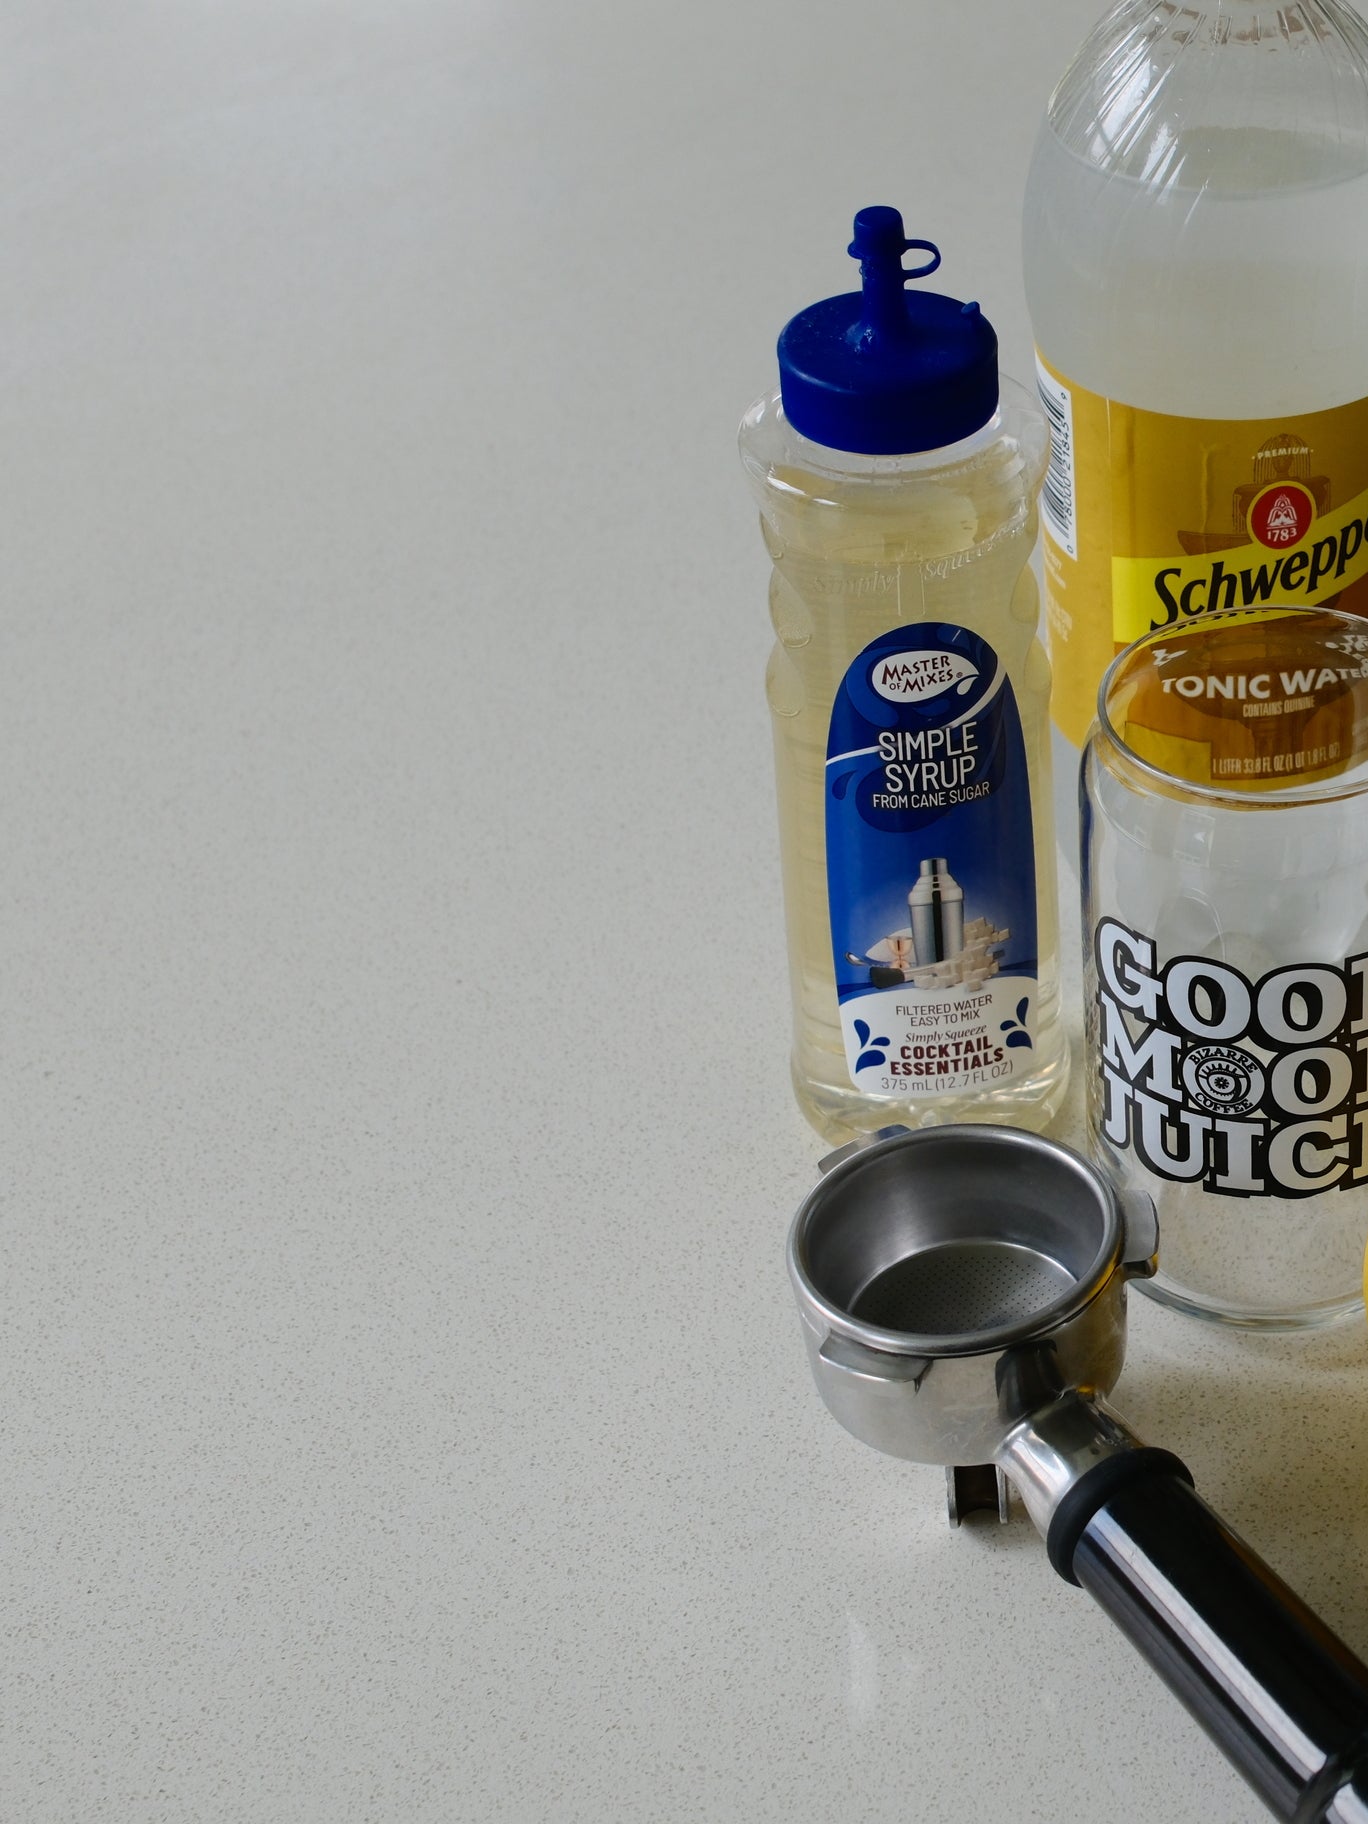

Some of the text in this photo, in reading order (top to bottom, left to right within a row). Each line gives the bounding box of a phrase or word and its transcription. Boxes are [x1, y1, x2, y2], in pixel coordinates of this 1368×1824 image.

[1257, 446, 1309, 460] PREMIUM
[1267, 526, 1298, 542] 1783
[881, 655, 951, 685] MASTER
[889, 682, 902, 691] OF
[1162, 674, 1271, 700] TONIC
[1242, 701, 1283, 718] CONTAINS
[878, 721, 979, 762] SIMPLE
[885, 754, 976, 793] SYRUP
[872, 781, 990, 809] FROM CANE SUGAR
[896, 993, 993, 1016] FILTERED WATER
[910, 1008, 980, 1027] EASY TO MIX
[905, 1024, 987, 1044] Simply Squeeze
[900, 1035, 993, 1060] COCKTAIL
[890, 1047, 1004, 1076] ESSENTIALS
[1188, 1047, 1258, 1074] BIZARRE
[881, 1059, 1014, 1091] 375 mL (12.7 FL OZ)
[1194, 1092, 1254, 1114] COFFEE
